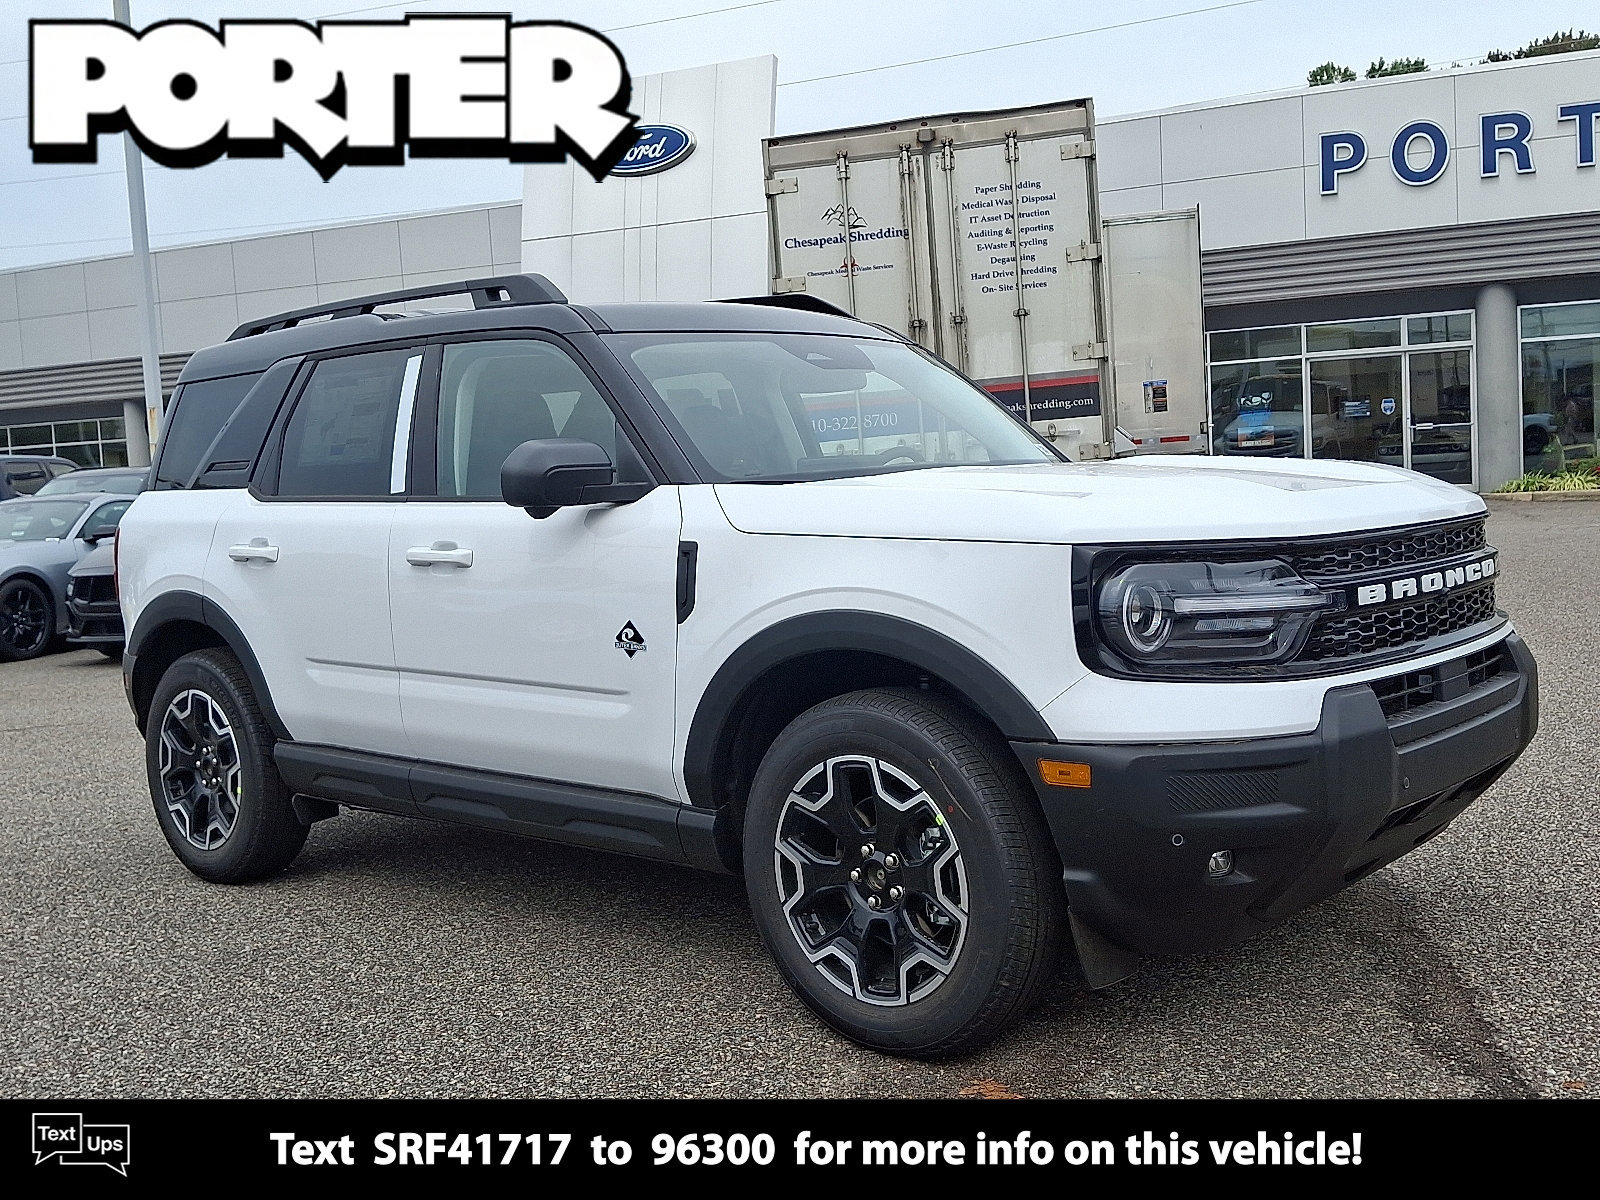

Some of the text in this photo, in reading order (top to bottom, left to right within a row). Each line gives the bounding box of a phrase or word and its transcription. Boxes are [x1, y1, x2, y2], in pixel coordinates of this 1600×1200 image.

[622, 132, 668, 162] ord
[975, 180, 1041, 195] Paper Shrdding
[961, 192, 1056, 210] Medical Was Disposal
[969, 209, 1050, 224] IT Asset Detruction
[784, 226, 909, 249] Chesapeak Shredding
[967, 223, 1054, 239] Auditing & eporting
[976, 238, 1048, 251] E-Waste Rcycling
[990, 253, 1036, 265] Degausing
[835, 266, 856, 275] Medil
[970, 265, 1057, 280] Hard Drive hredding
[998, 283, 1014, 292] Site
[1358, 558, 1495, 605] BRONCO
